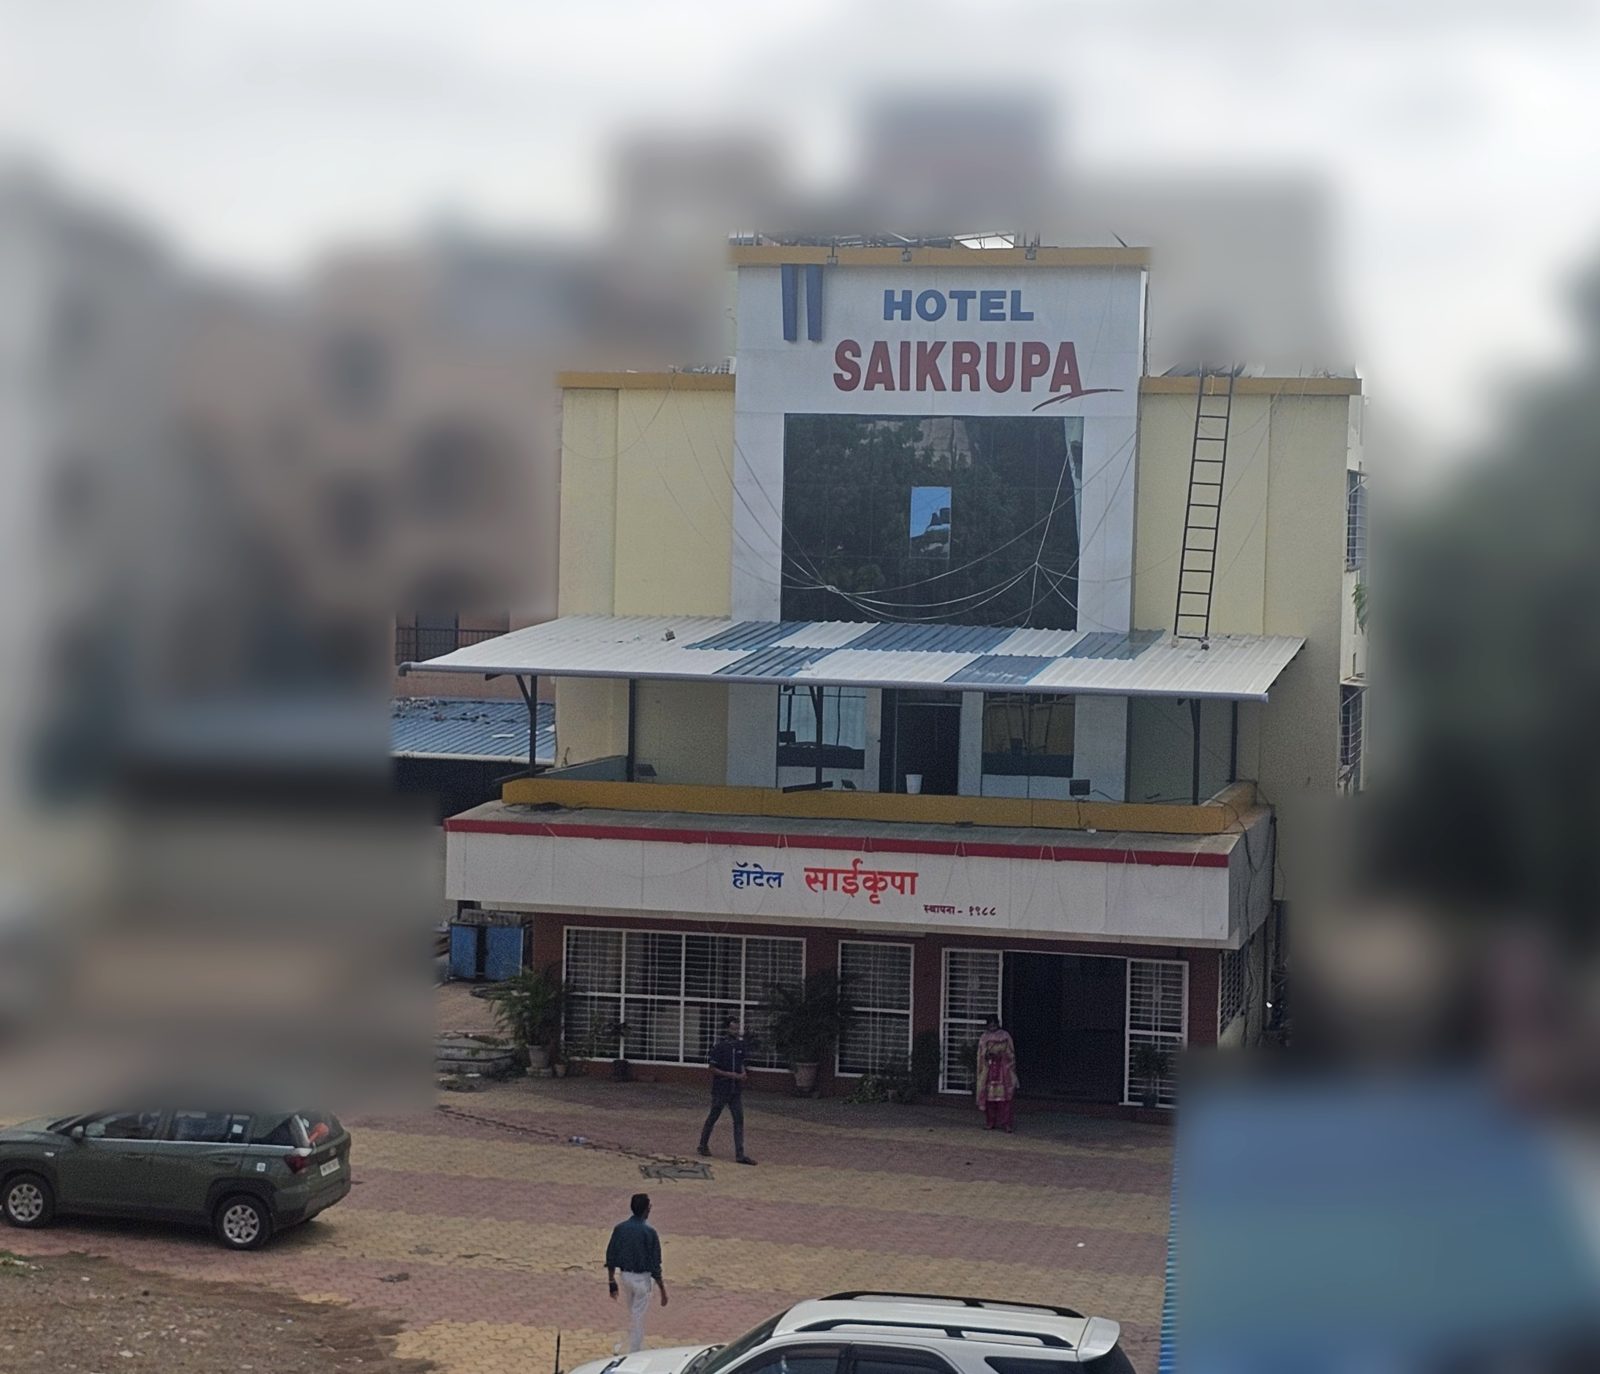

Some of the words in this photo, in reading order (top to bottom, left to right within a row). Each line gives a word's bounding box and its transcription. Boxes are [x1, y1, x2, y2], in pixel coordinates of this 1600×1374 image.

[883, 288, 1034, 322] HOTEL
[833, 339, 1084, 394] SAIKRUPA
[732, 861, 784, 889] हॉटेल
[804, 858, 919, 905] साईकृपा
[923, 904, 955, 915] स्थापना
